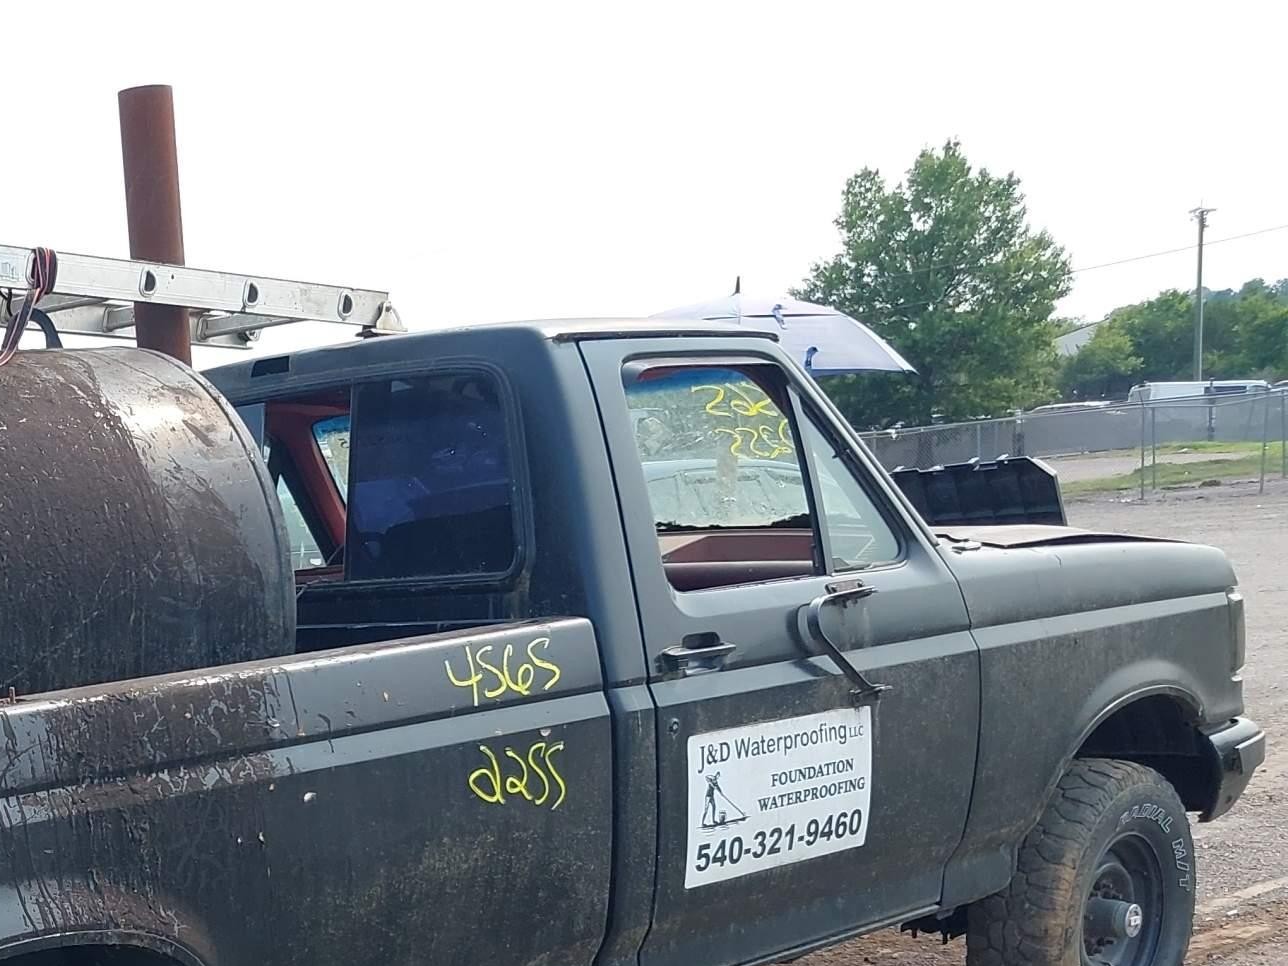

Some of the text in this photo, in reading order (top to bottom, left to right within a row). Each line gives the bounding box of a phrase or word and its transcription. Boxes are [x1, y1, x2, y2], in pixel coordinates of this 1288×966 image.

[444, 637, 561, 707] 4565
[469, 740, 566, 811] 2255
[697, 722, 864, 774] J&D Waterproofing LLC
[770, 757, 855, 788] FOUNDATION
[757, 776, 866, 812] WATERPROOFING
[695, 808, 863, 873] 540-321-9460
